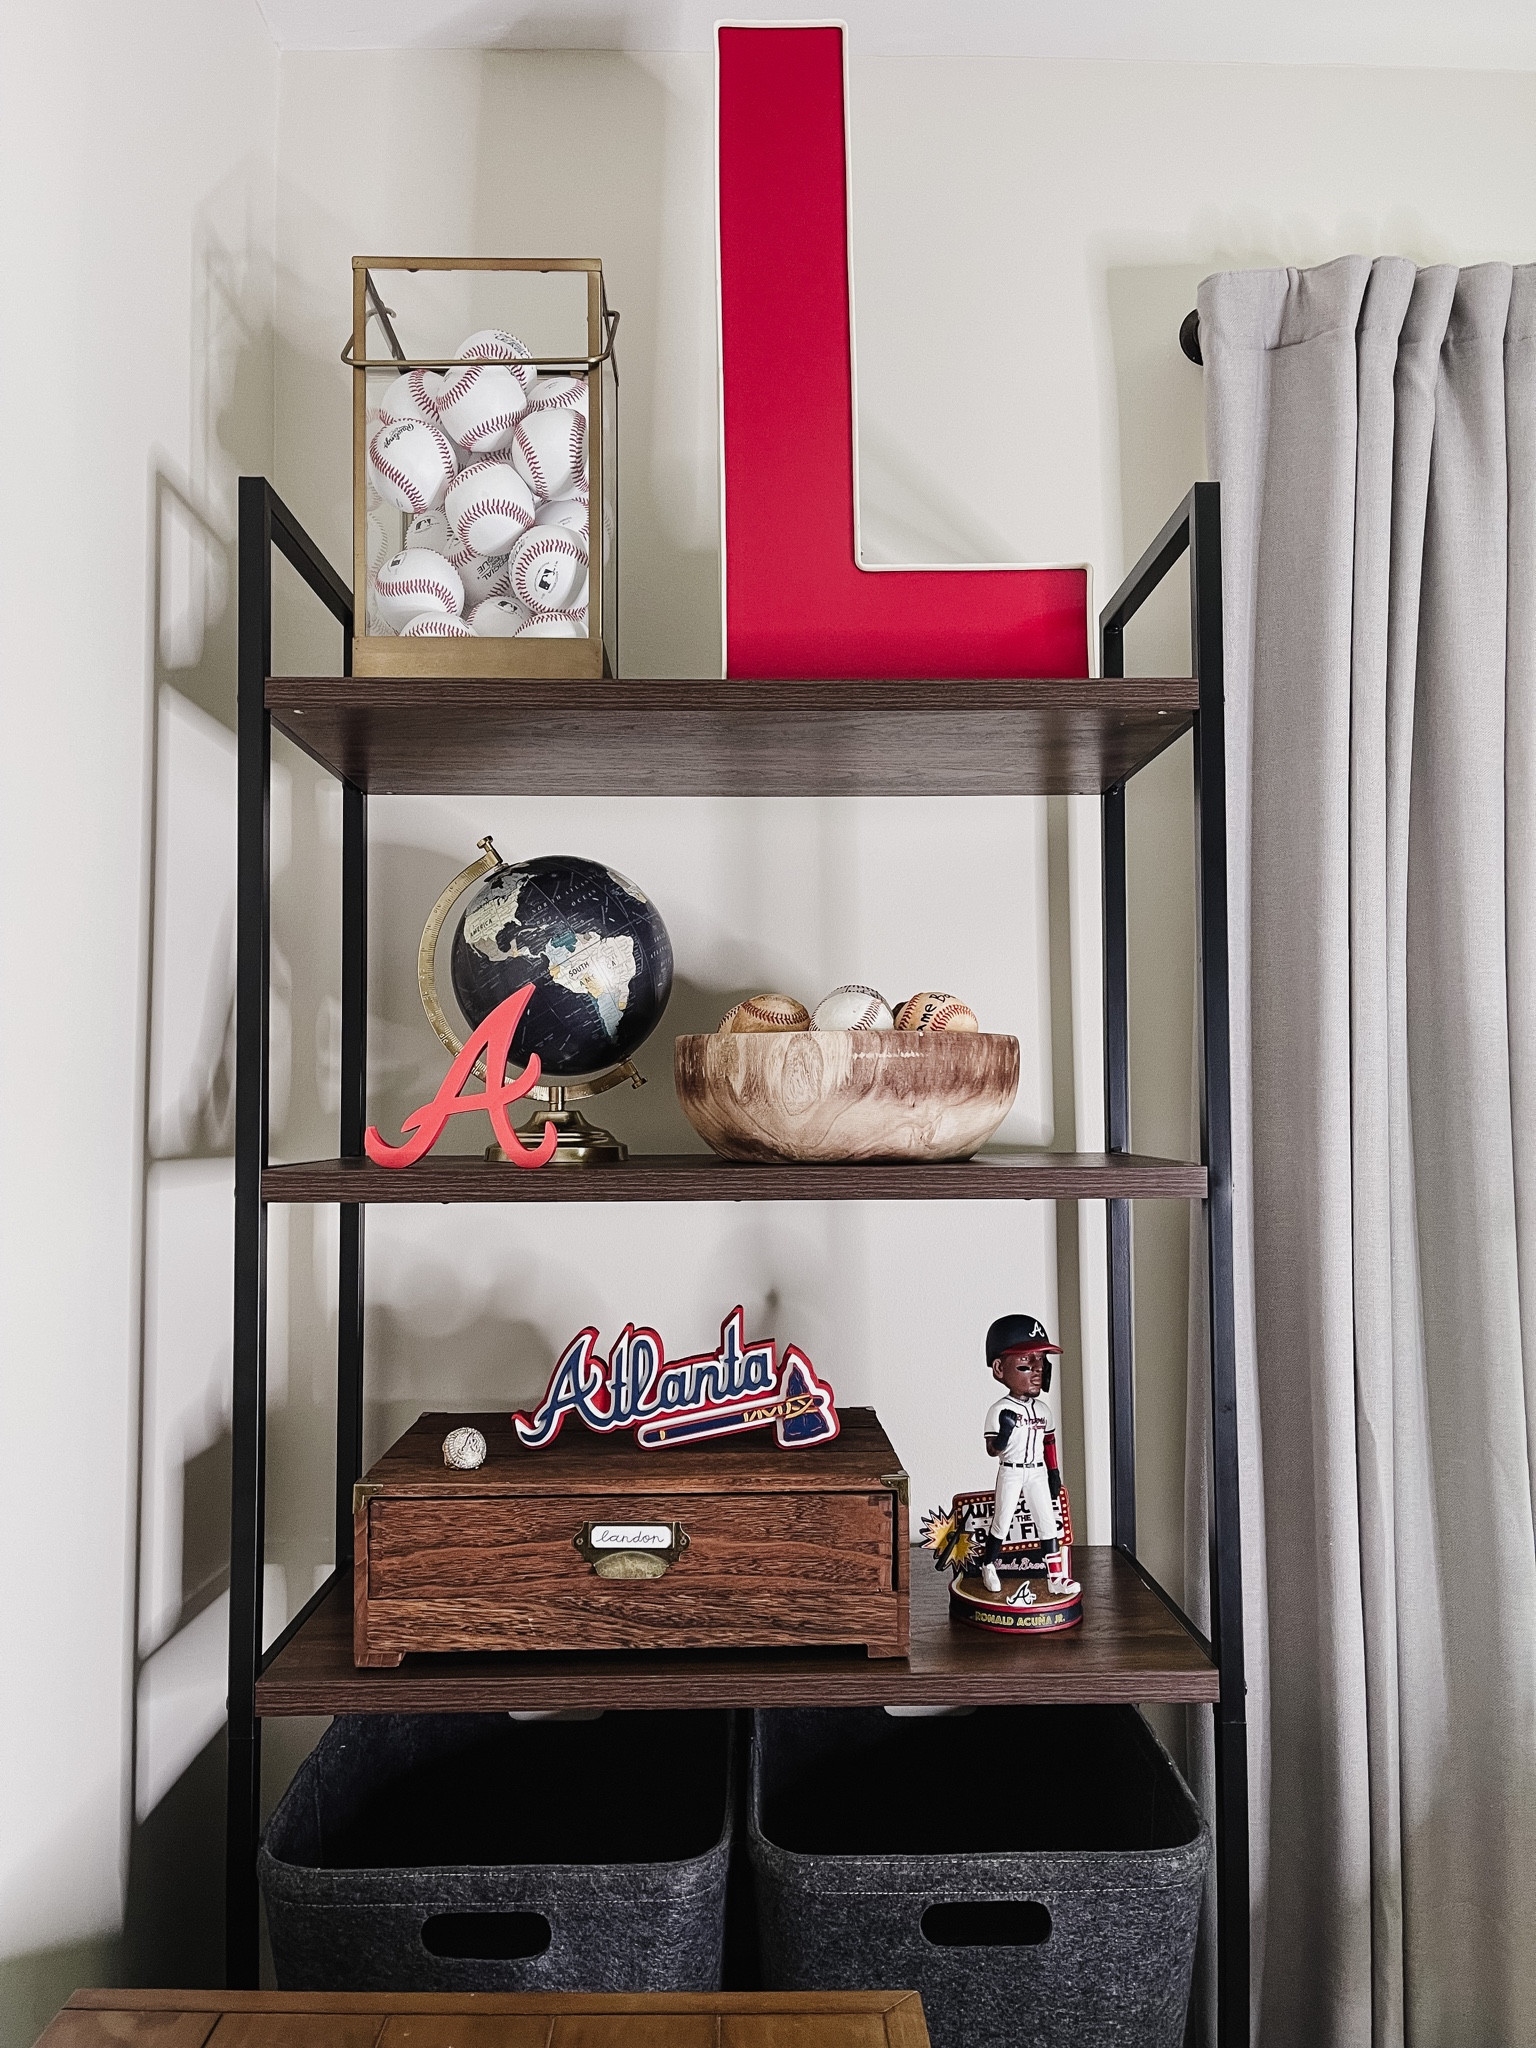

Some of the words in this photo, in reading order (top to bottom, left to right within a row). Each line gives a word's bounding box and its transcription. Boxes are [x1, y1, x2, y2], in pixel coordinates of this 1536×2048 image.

[714, 20, 1098, 679] L
[568, 961, 590, 977] SOUTH
[364, 982, 557, 1169] A
[1028, 1321, 1045, 1338] A
[513, 1306, 776, 1450] Atlanta
[1015, 1514, 1033, 1523] THE
[596, 1529, 665, 1544] landon
[975, 1611, 1015, 1626] RONALD
